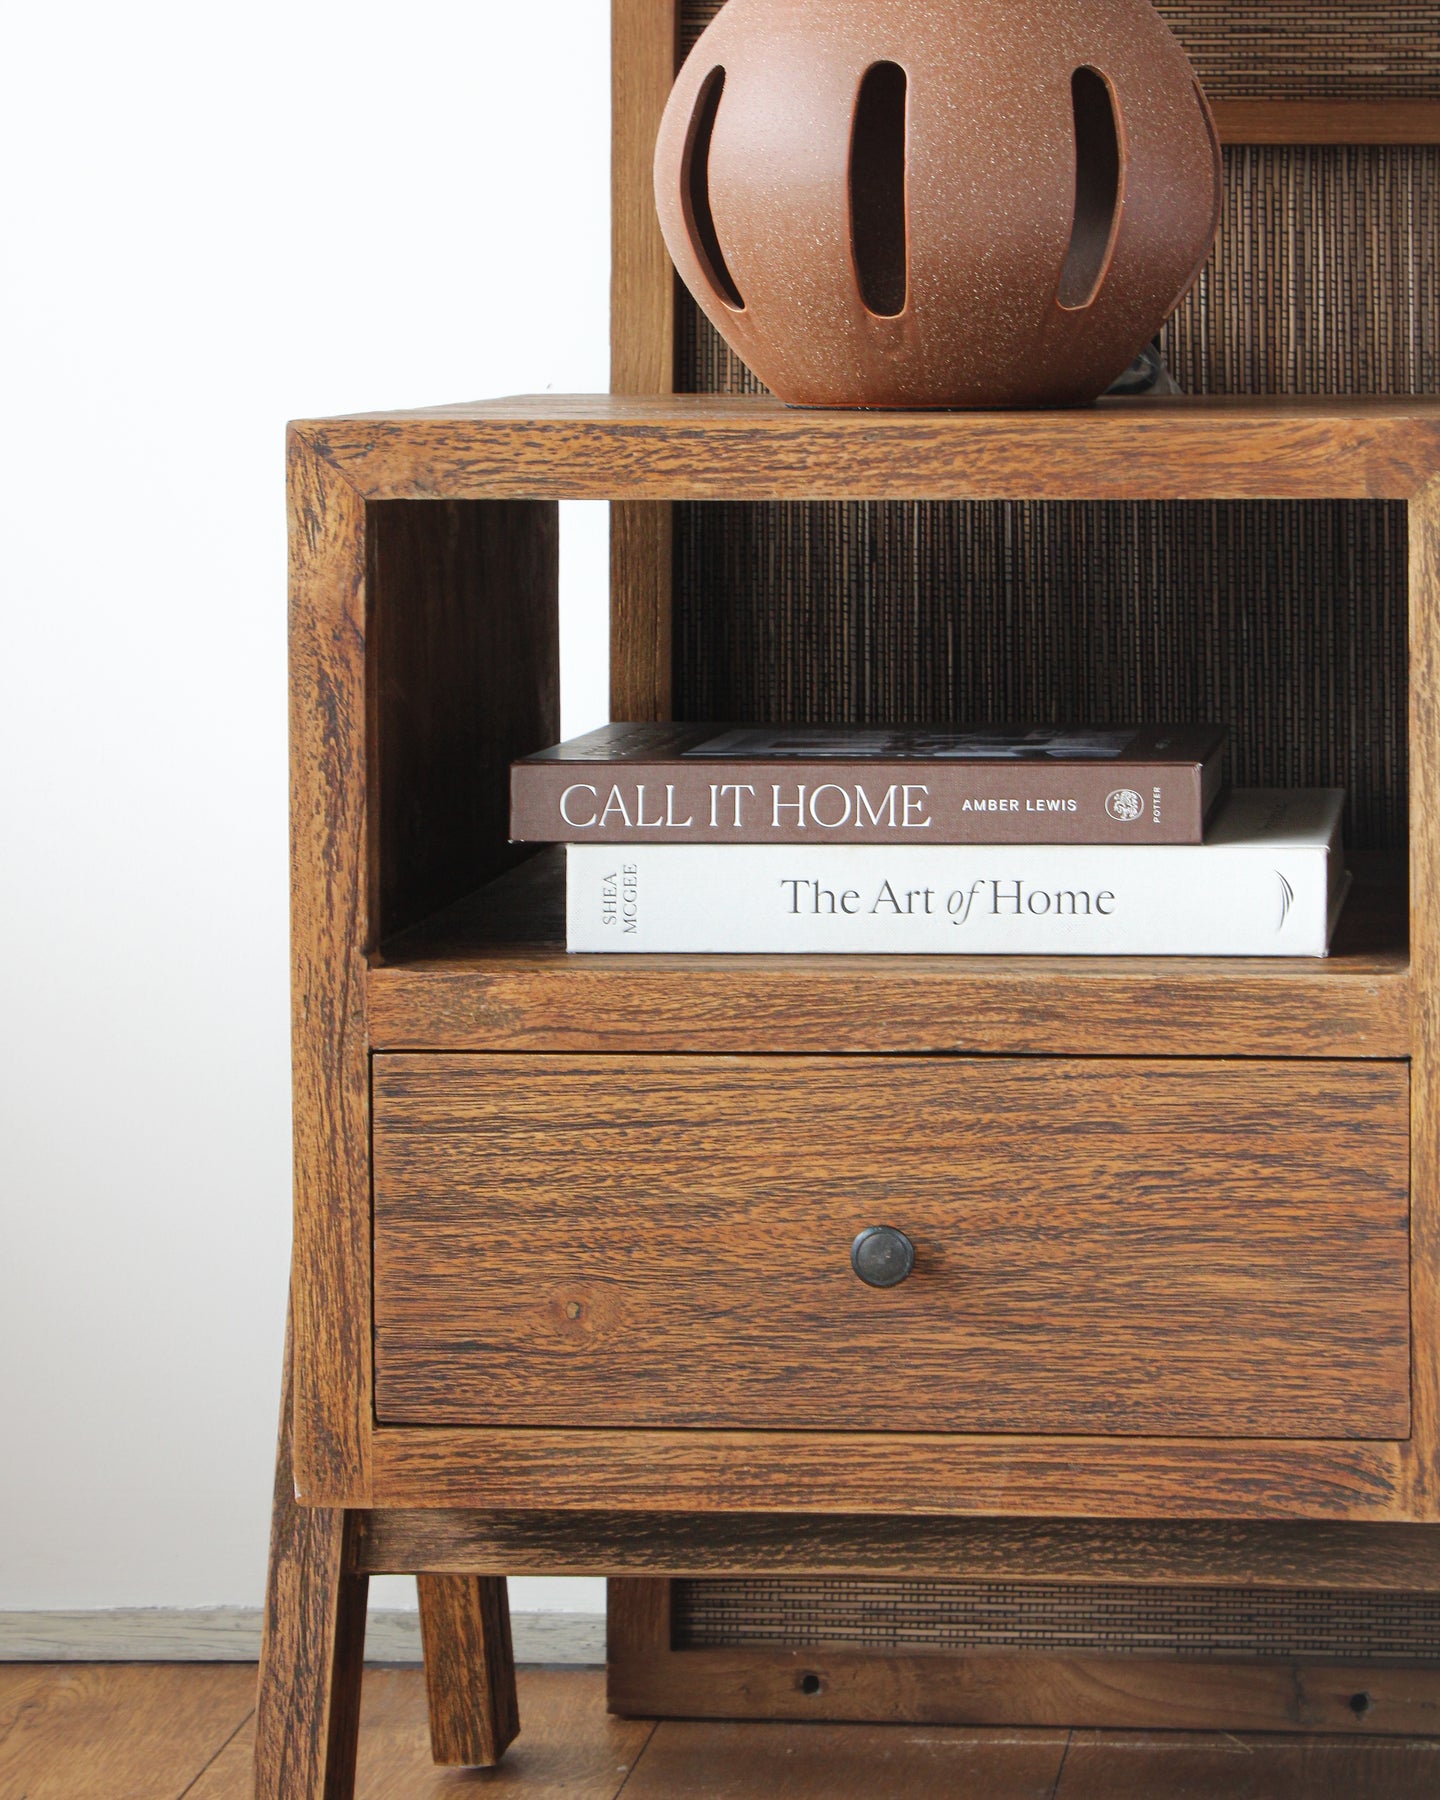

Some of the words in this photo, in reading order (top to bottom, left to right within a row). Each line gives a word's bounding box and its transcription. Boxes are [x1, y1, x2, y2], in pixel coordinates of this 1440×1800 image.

[559, 784, 693, 828] CALL
[709, 784, 756, 828] IT
[771, 784, 932, 828] HOME
[961, 799, 1020, 812] AMBER
[1026, 799, 1077, 812] LEWIS
[1152, 786, 1161, 824] POTTER
[602, 872, 617, 925] SHEA
[622, 863, 638, 934] MCGEE
[780, 879, 861, 915] The
[869, 879, 935, 915] Art
[946, 879, 986, 926] of
[989, 879, 1116, 915] Home
